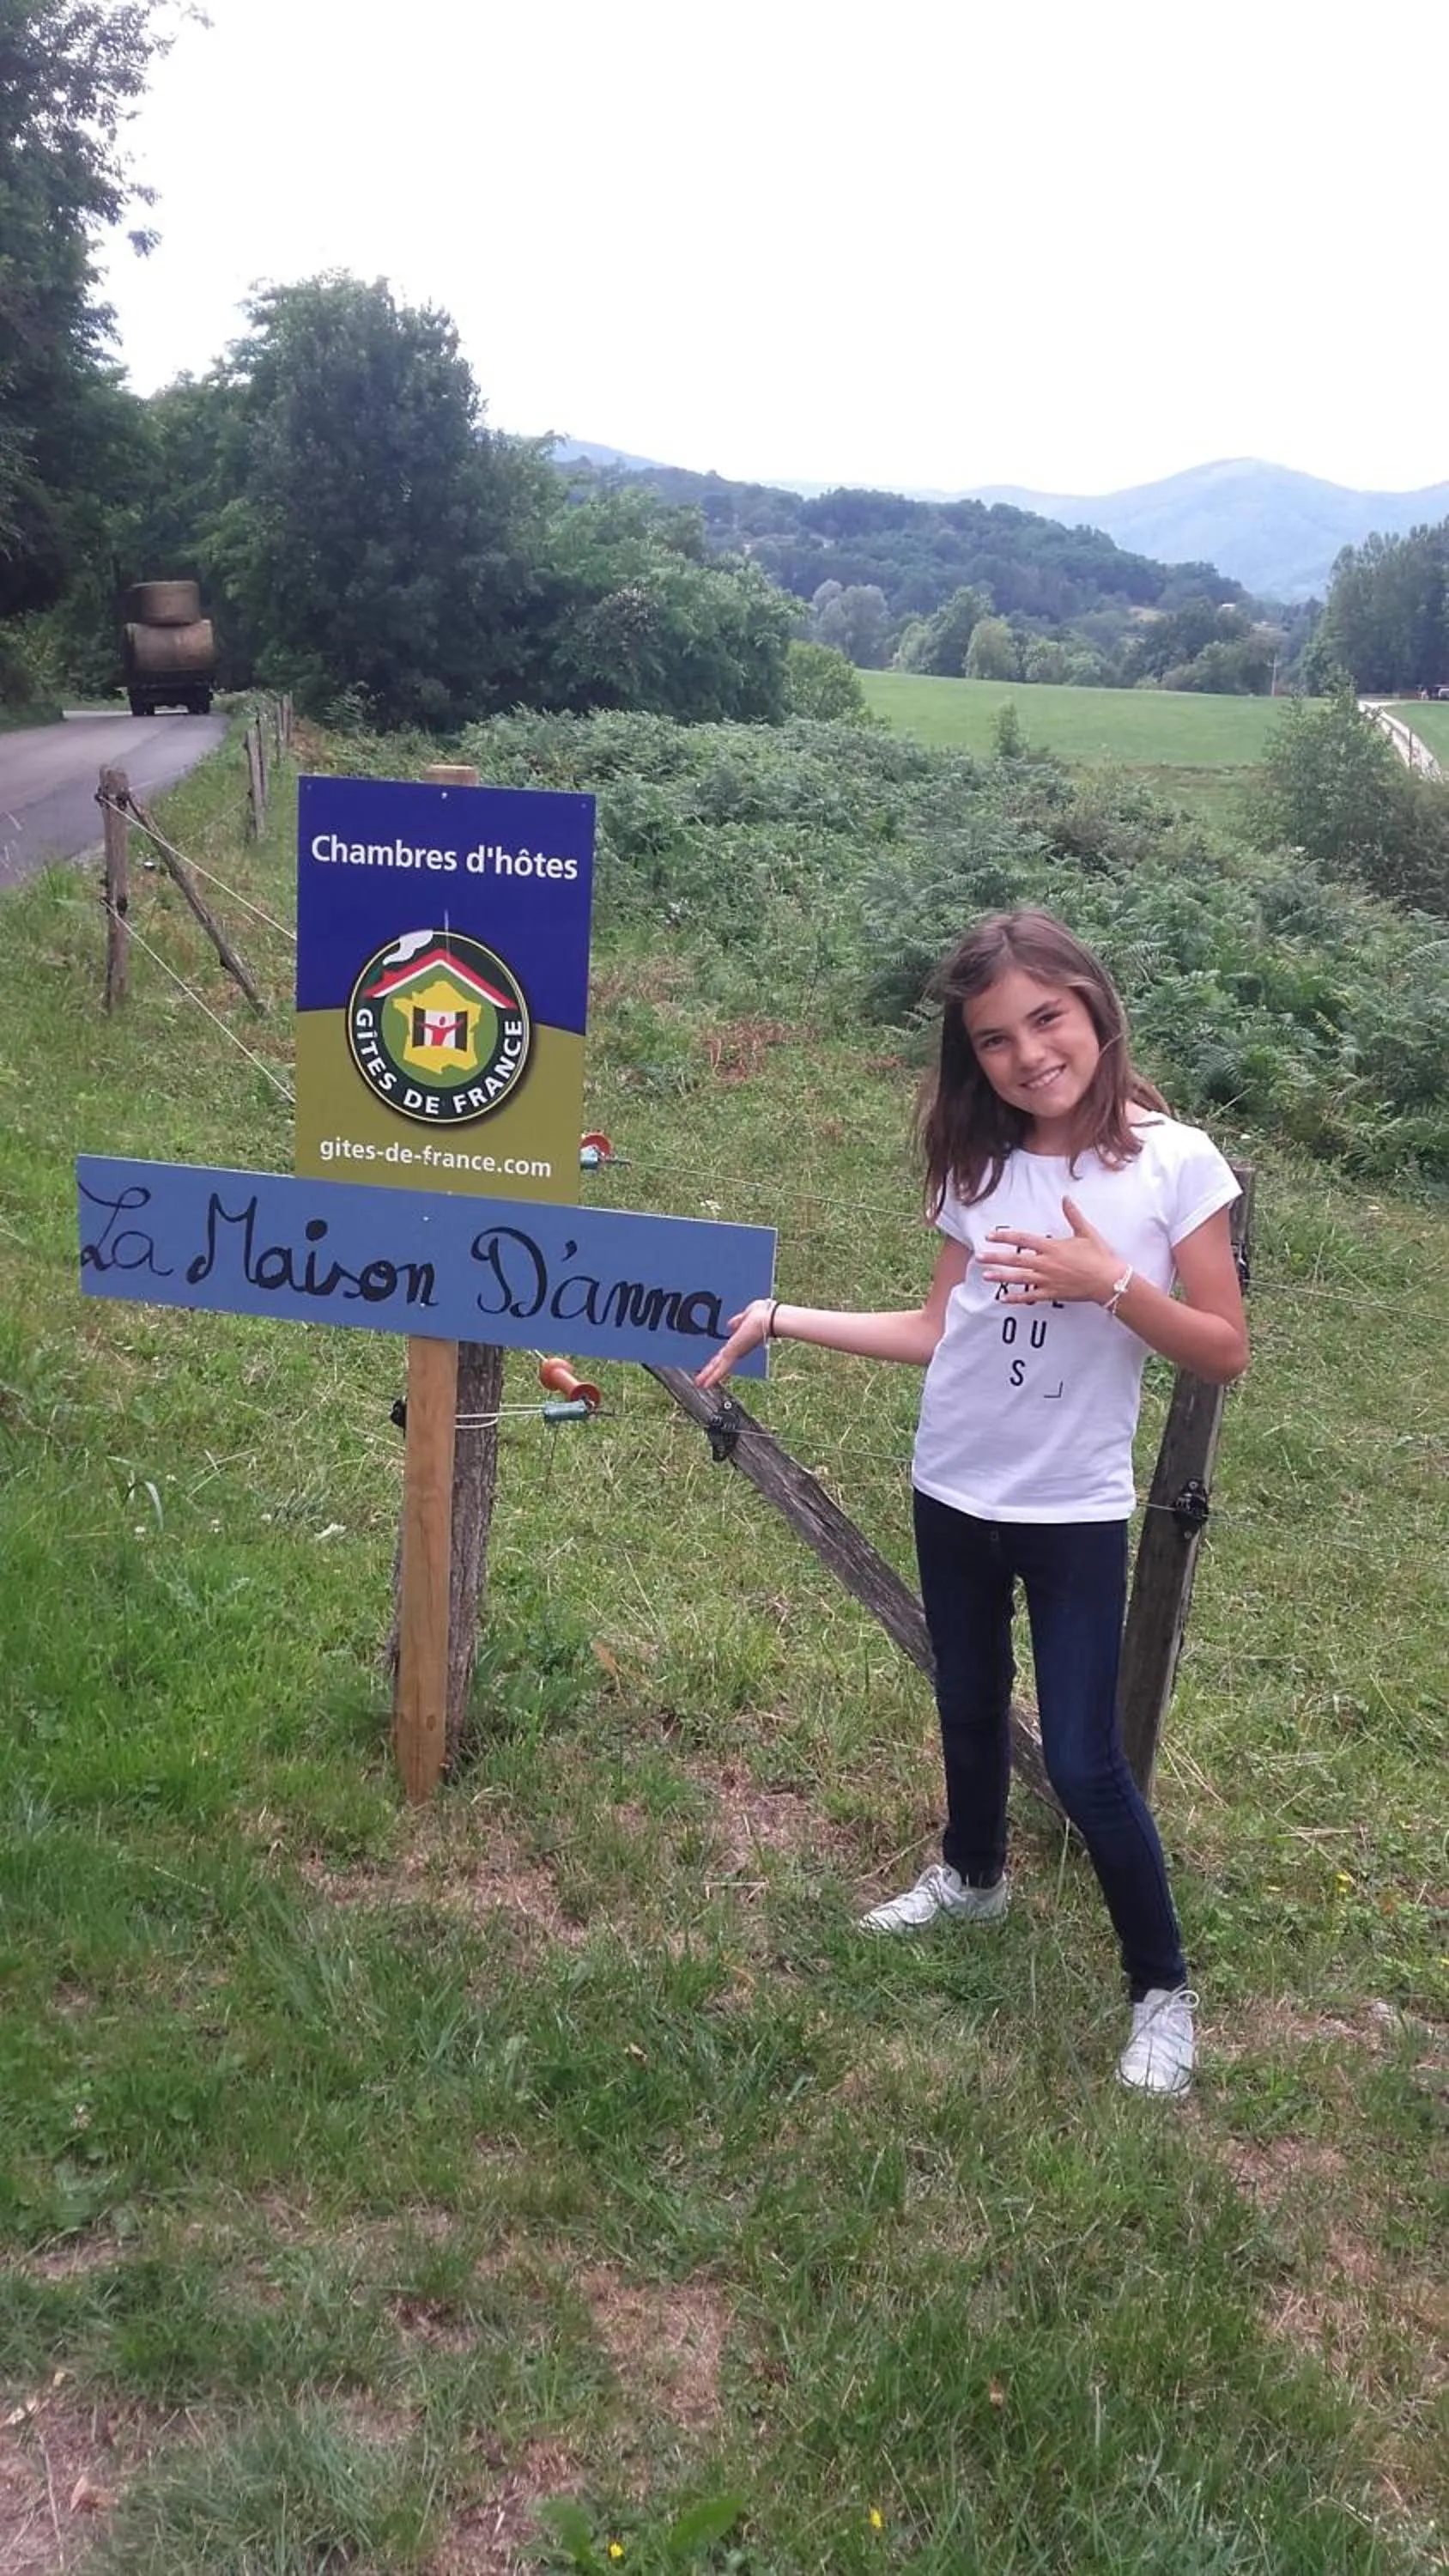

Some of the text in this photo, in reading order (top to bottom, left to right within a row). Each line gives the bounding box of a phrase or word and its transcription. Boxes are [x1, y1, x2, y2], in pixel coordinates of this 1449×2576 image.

[311, 835, 579, 880] Chambres d'hôtes
[404, 1088, 440, 1115] DE
[452, 1020, 523, 1114] FRANCE
[319, 1137, 552, 1177] gites-de-france.com
[78, 1182, 174, 1276] La
[186, 1193, 440, 1307] Maison
[1009, 1359, 1026, 1386] S
